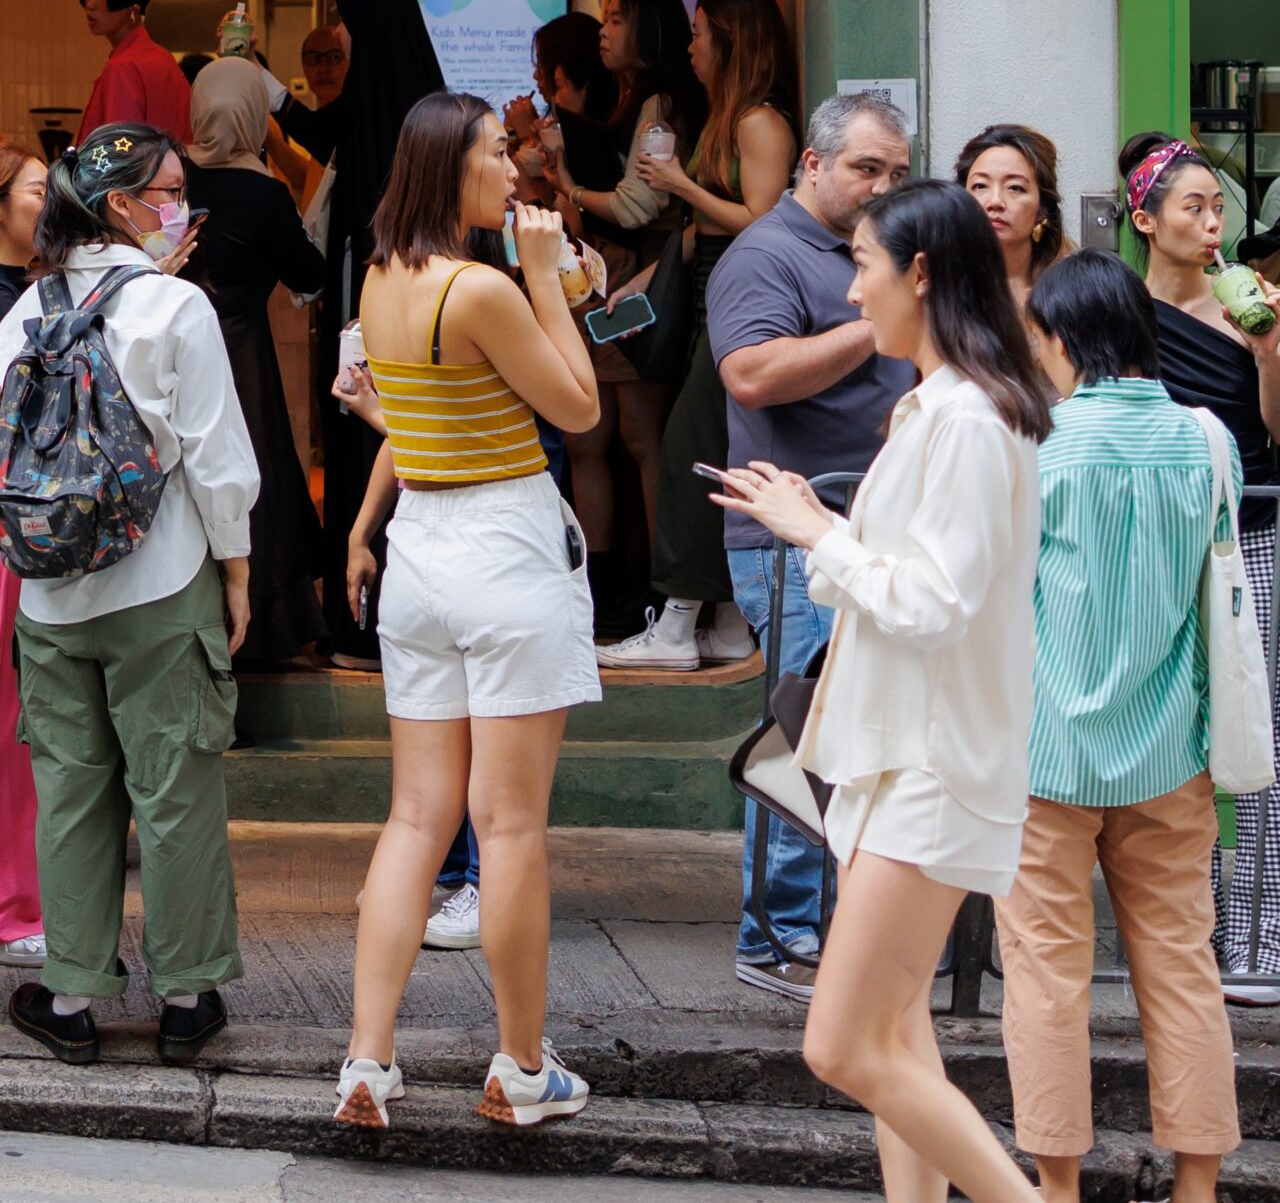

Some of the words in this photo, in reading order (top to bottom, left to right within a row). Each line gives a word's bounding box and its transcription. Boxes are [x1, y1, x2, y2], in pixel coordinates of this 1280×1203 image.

[432, 26, 455, 37] Kids
[460, 26, 491, 37] Menu
[496, 26, 527, 37] made
[441, 40, 459, 52] the
[464, 40, 496, 52] whole
